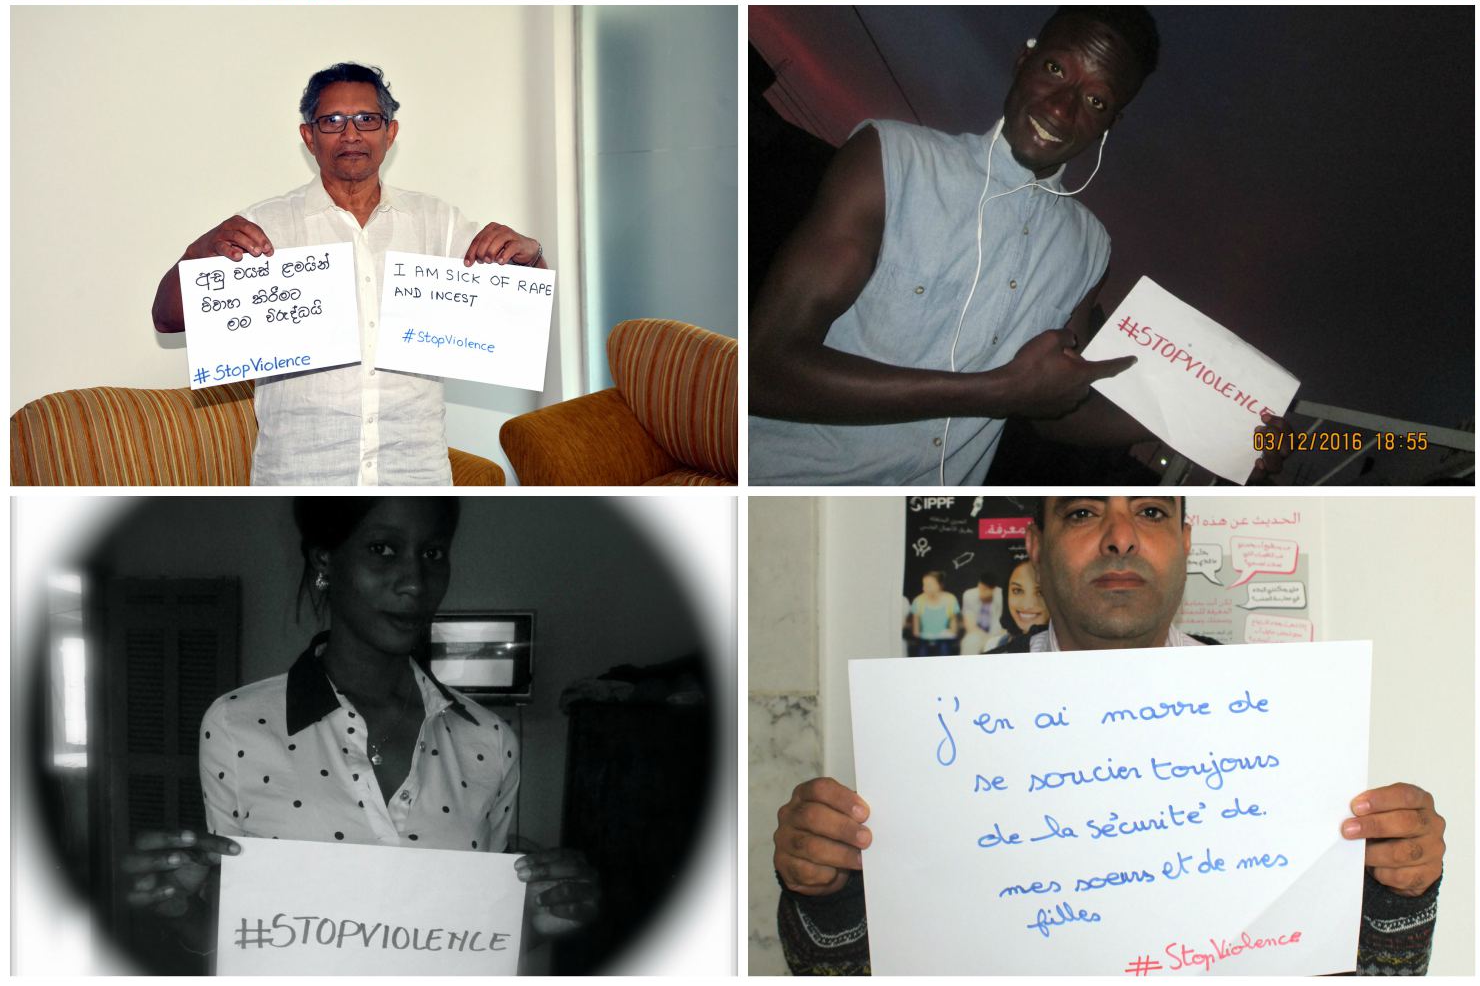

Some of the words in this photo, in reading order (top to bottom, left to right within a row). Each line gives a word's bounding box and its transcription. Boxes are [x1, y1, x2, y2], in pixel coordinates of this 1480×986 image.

[196, 270, 225, 290] අඩු
[234, 261, 269, 280] වයස්
[394, 264, 405, 276] I
[415, 266, 439, 279] AM
[446, 269, 481, 284] SICK
[490, 276, 510, 288] OF
[518, 280, 552, 296] RAPE
[395, 287, 422, 298] AND
[431, 291, 478, 307] INCEST
[227, 316, 251, 331] මම
[402, 329, 495, 353] #StopViolence
[1118, 316, 1276, 417] #STOPVIOLENCE
[924, 497, 955, 509] IPPF
[1035, 707, 1069, 728] ai
[1101, 700, 1211, 725] marre
[1228, 691, 1269, 714] de
[973, 773, 1008, 793] se
[1028, 762, 1142, 791] soucier
[1150, 752, 1280, 790] toujours
[978, 824, 1022, 848] de
[1030, 815, 1078, 842] la
[1091, 802, 1206, 838] sécurité
[999, 879, 1061, 898] mes
[1162, 850, 1192, 880] et
[1197, 848, 1226, 873] de
[1237, 852, 1288, 869] mes
[235, 913, 511, 952] #STOPVIOLENCE
[1027, 904, 1101, 937] filles
